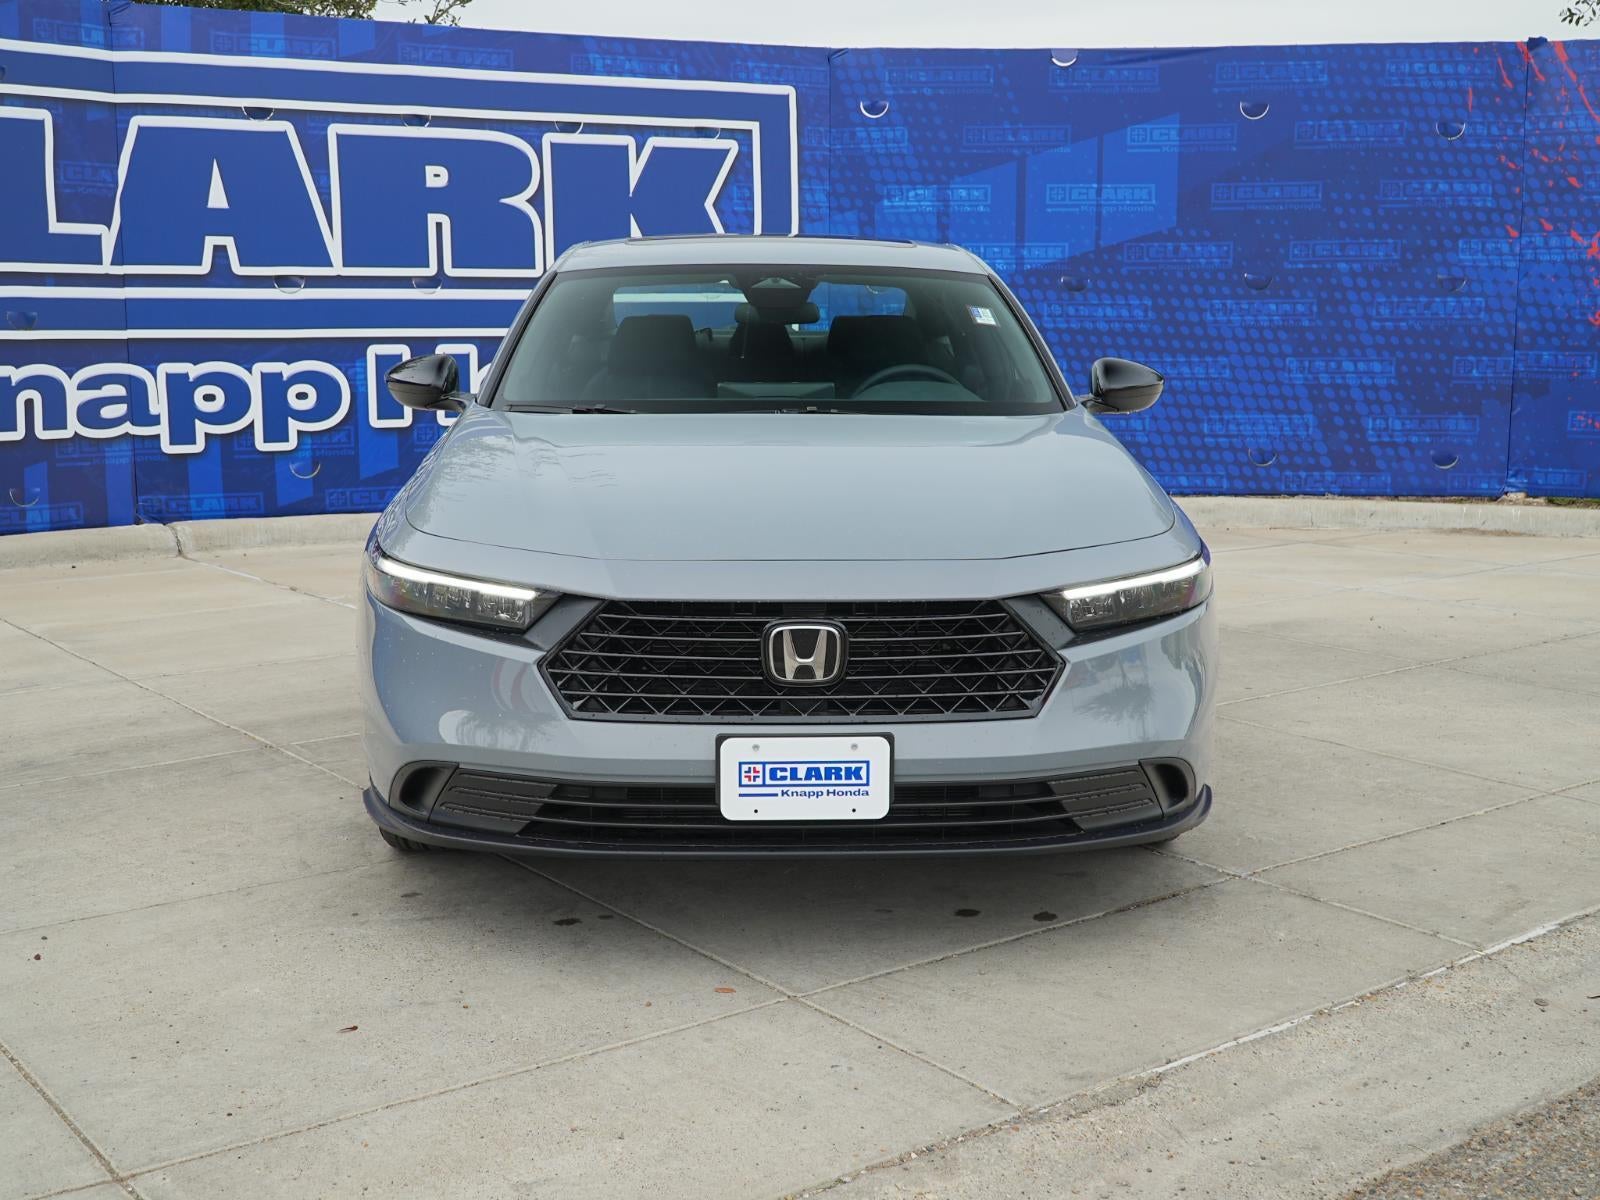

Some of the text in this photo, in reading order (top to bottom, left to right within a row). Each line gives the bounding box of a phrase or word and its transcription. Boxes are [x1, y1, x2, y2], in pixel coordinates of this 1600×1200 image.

[768, 766, 864, 782] CLARK
[781, 788, 869, 799] Knapp Honda
